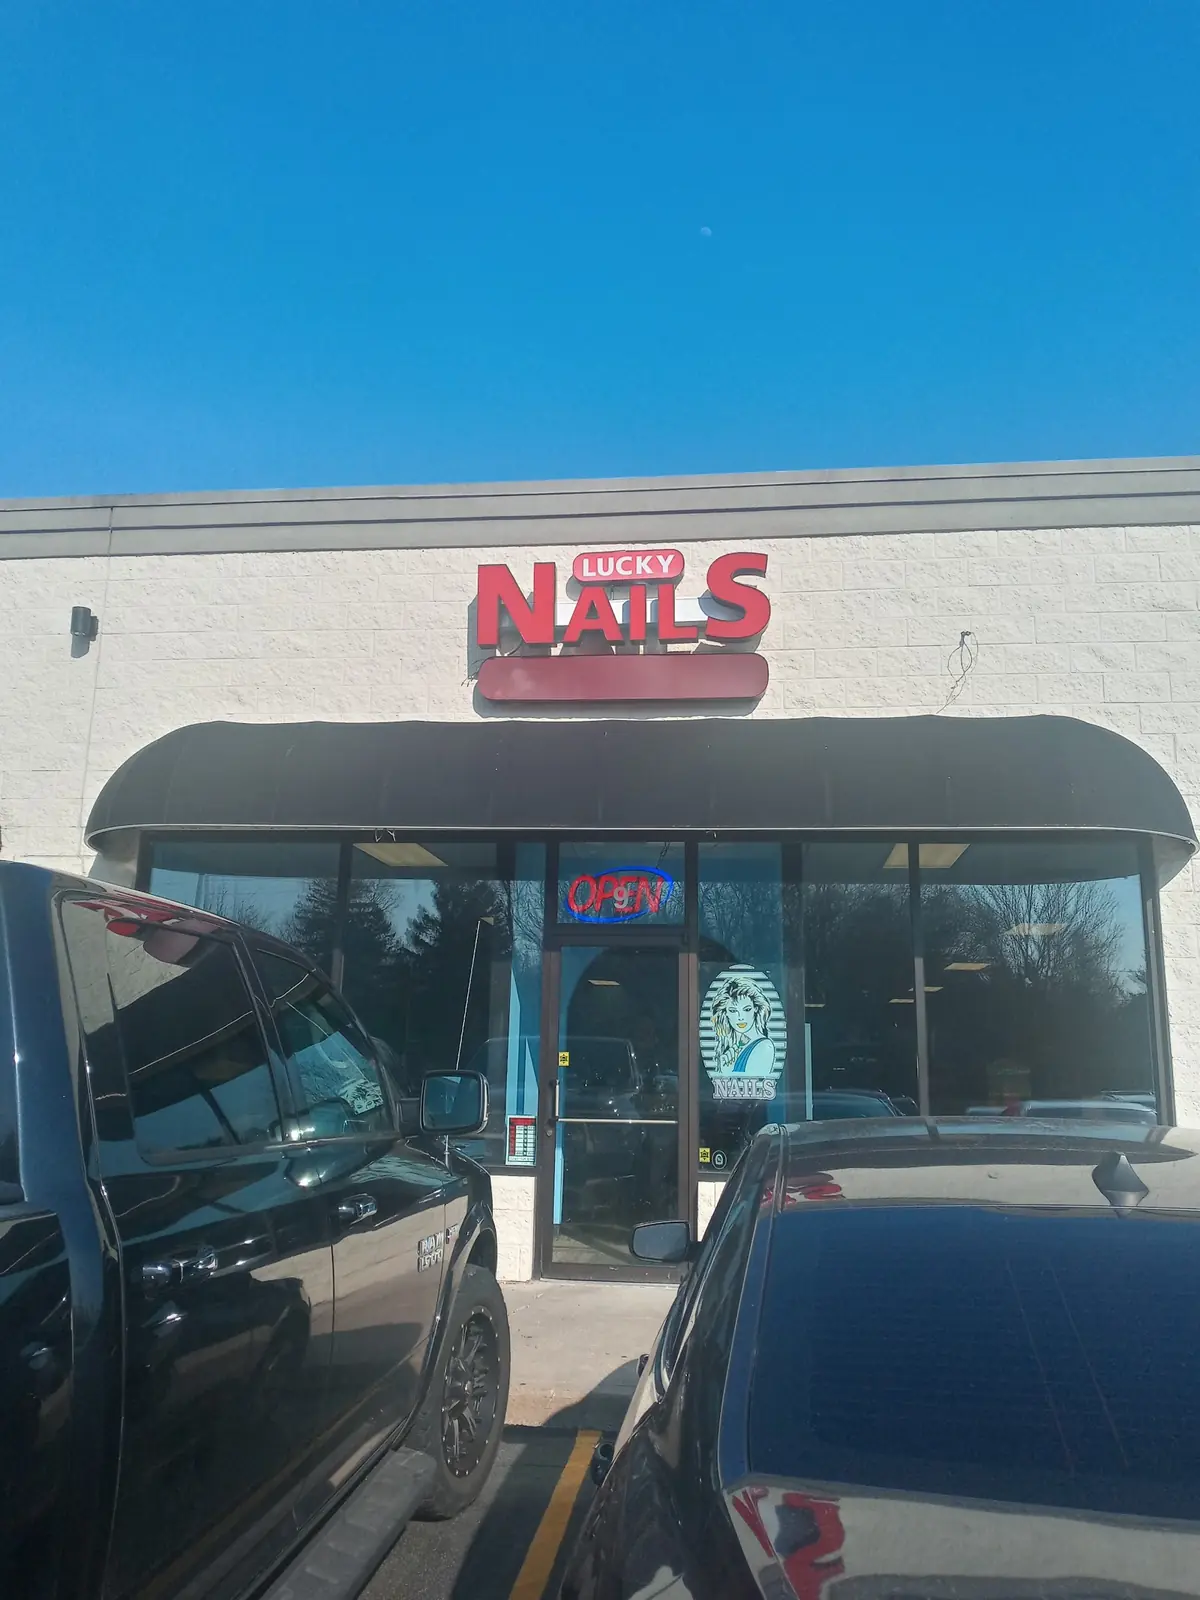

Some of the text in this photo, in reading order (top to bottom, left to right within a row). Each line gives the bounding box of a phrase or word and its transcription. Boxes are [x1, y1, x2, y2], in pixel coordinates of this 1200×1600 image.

[582, 554, 675, 577] LUCKY
[477, 551, 771, 646] NAILS
[568, 874, 664, 913] OPEN
[613, 886, 628, 909] 9
[712, 1077, 777, 1100] NAILS
